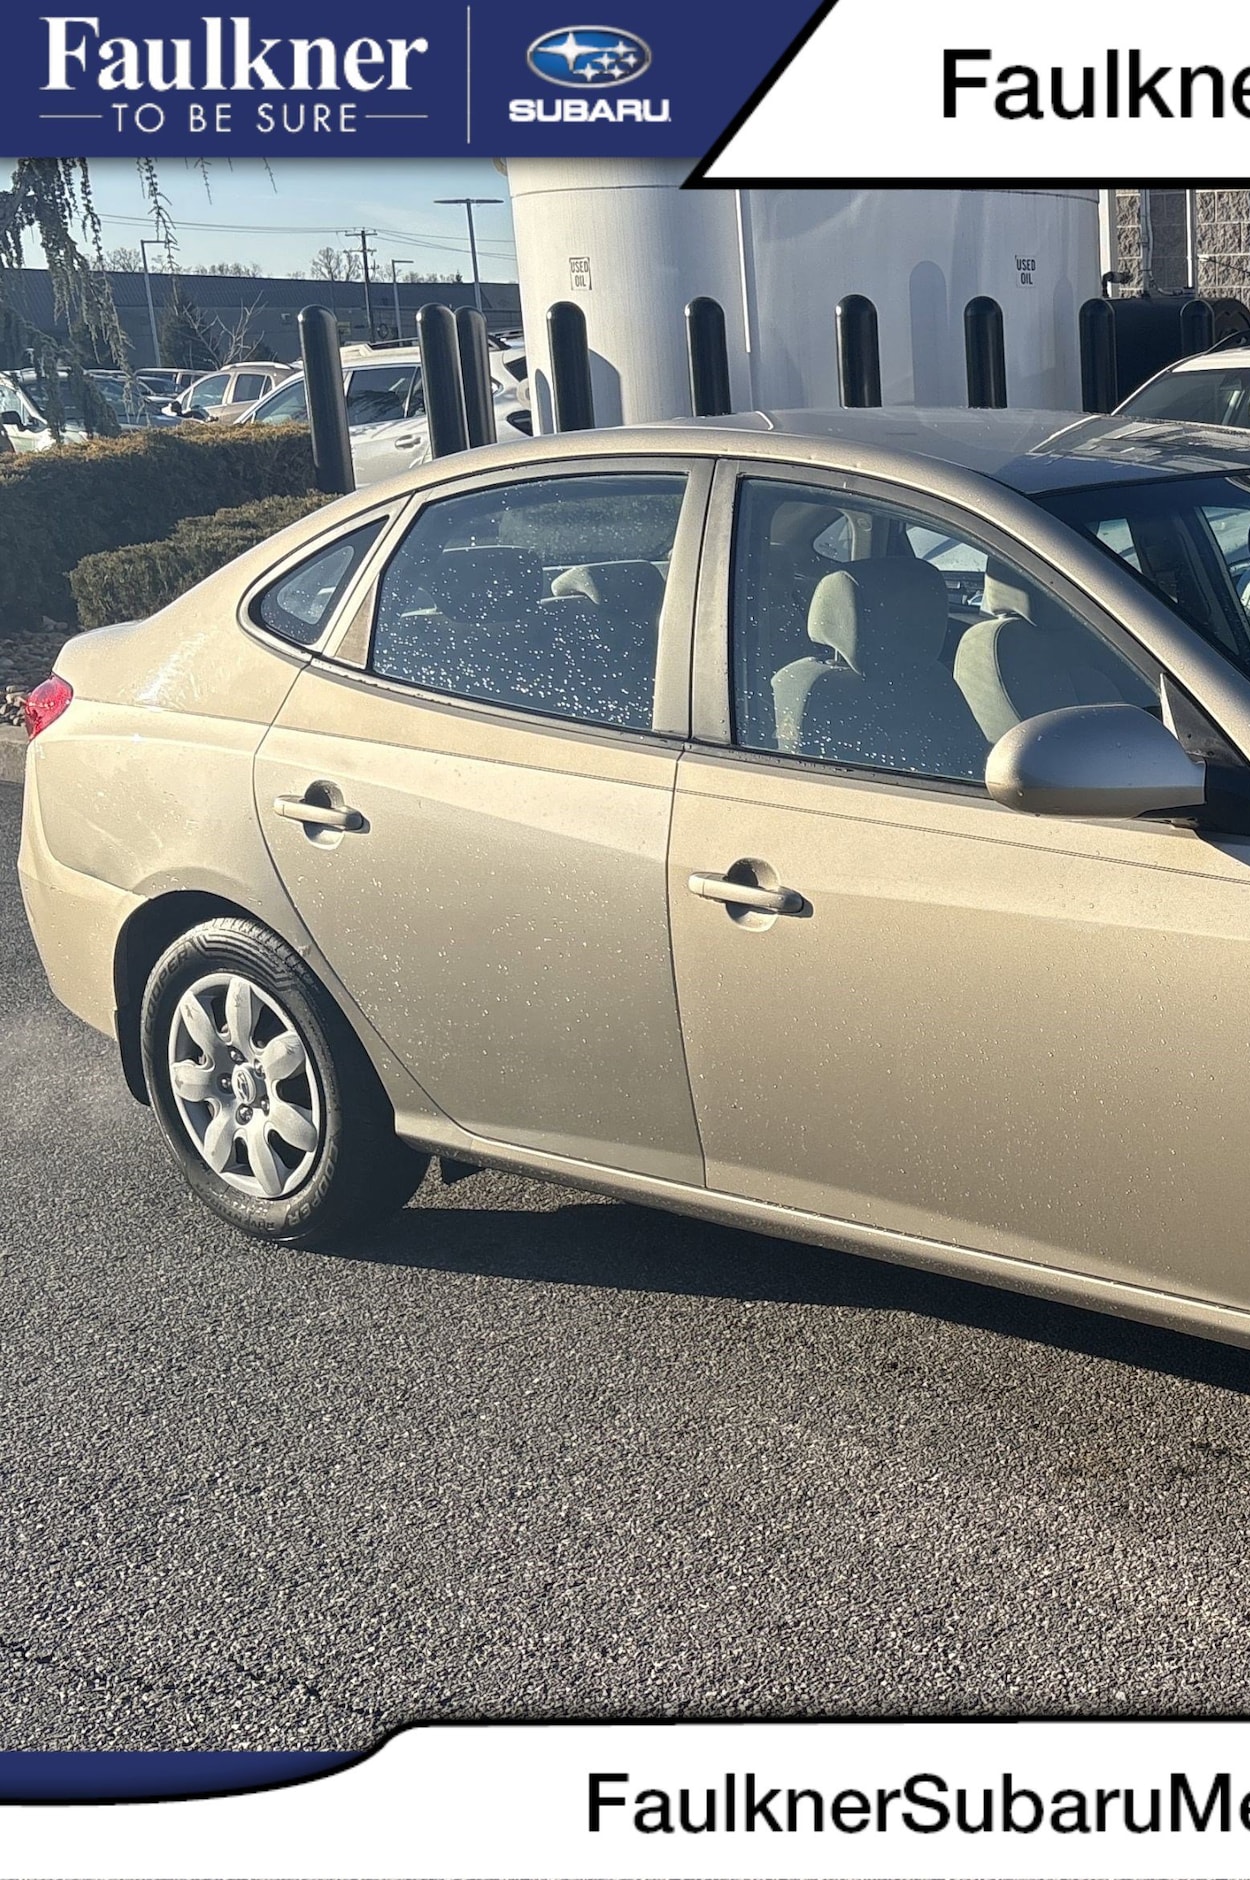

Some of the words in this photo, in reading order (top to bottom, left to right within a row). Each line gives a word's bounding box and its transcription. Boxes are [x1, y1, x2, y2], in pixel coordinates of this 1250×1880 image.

[570, 260, 589, 273] USED
[1016, 258, 1036, 271] USED
[575, 274, 587, 287] OIL
[1020, 272, 1033, 285] OIL
[144, 945, 188, 1034] COOPER
[287, 1140, 339, 1226] COOPER
